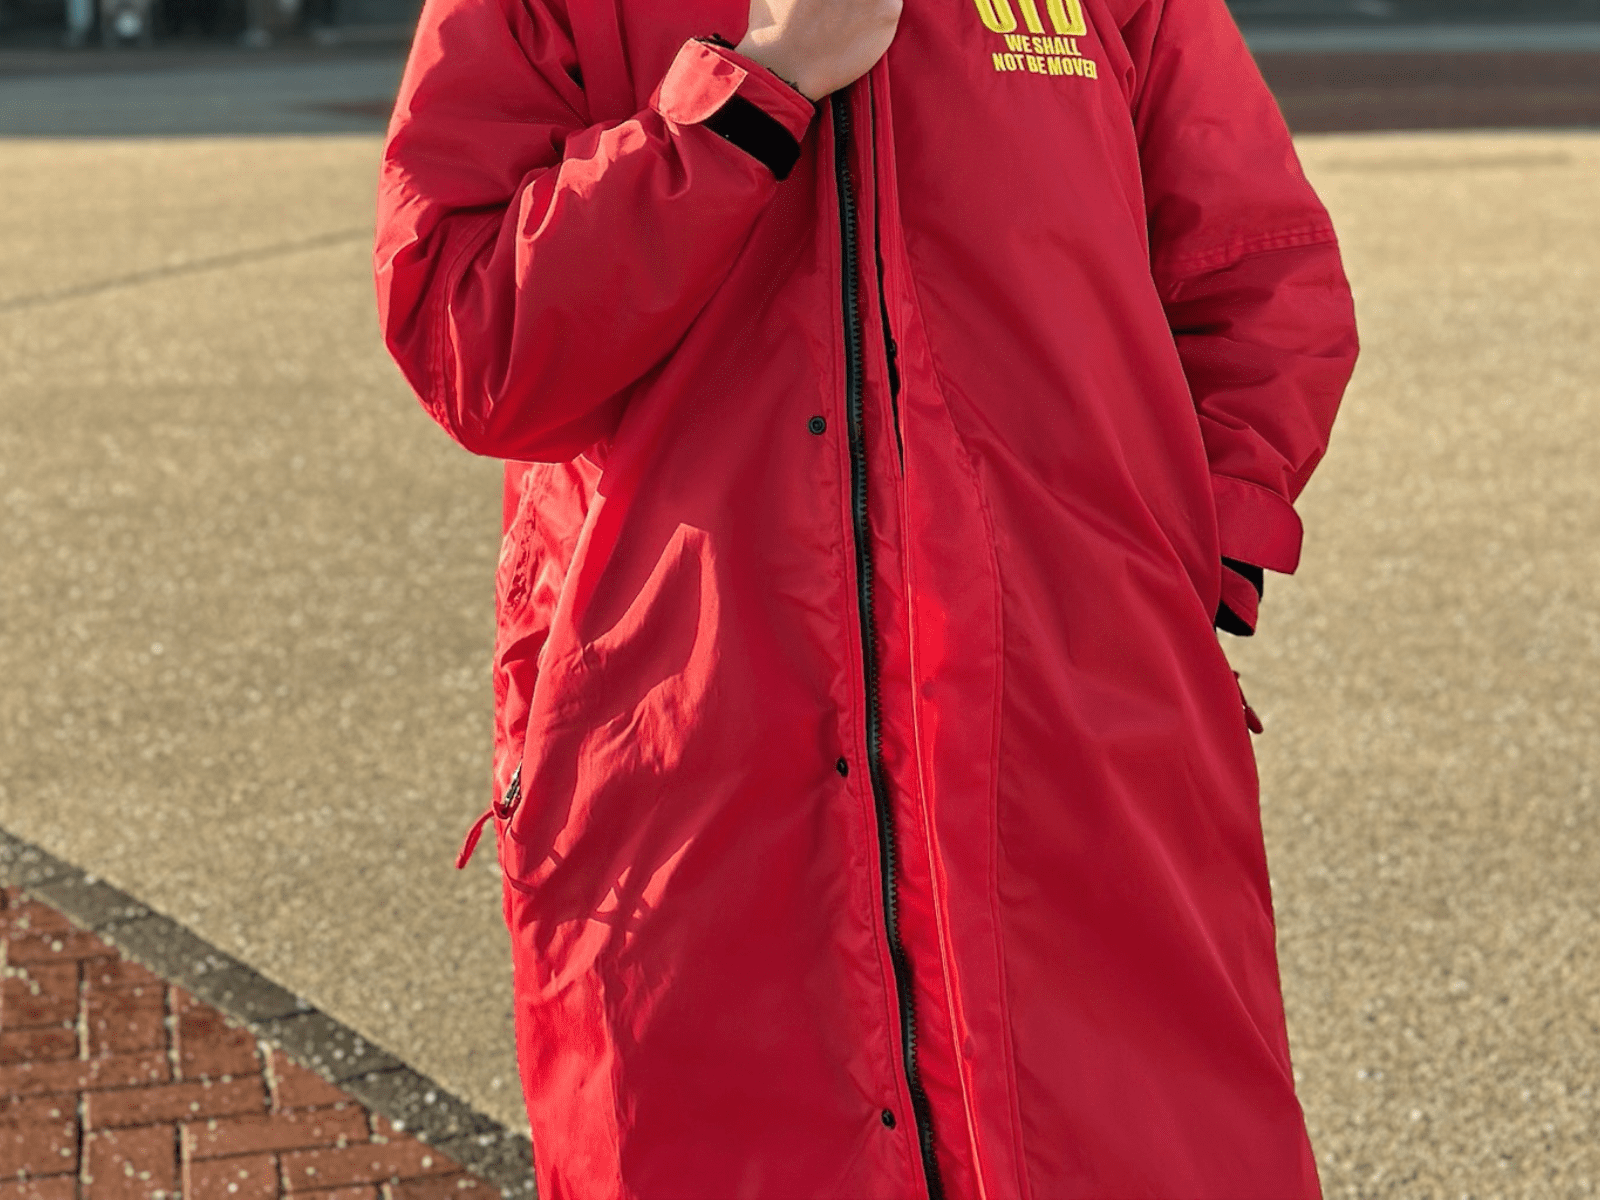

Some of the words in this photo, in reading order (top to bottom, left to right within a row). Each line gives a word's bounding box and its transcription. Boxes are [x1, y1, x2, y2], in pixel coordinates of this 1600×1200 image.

[1004, 34, 1032, 53] WE
[1032, 36, 1082, 56] SHALL
[992, 52, 1025, 71] NOT
[1026, 54, 1048, 75] BE
